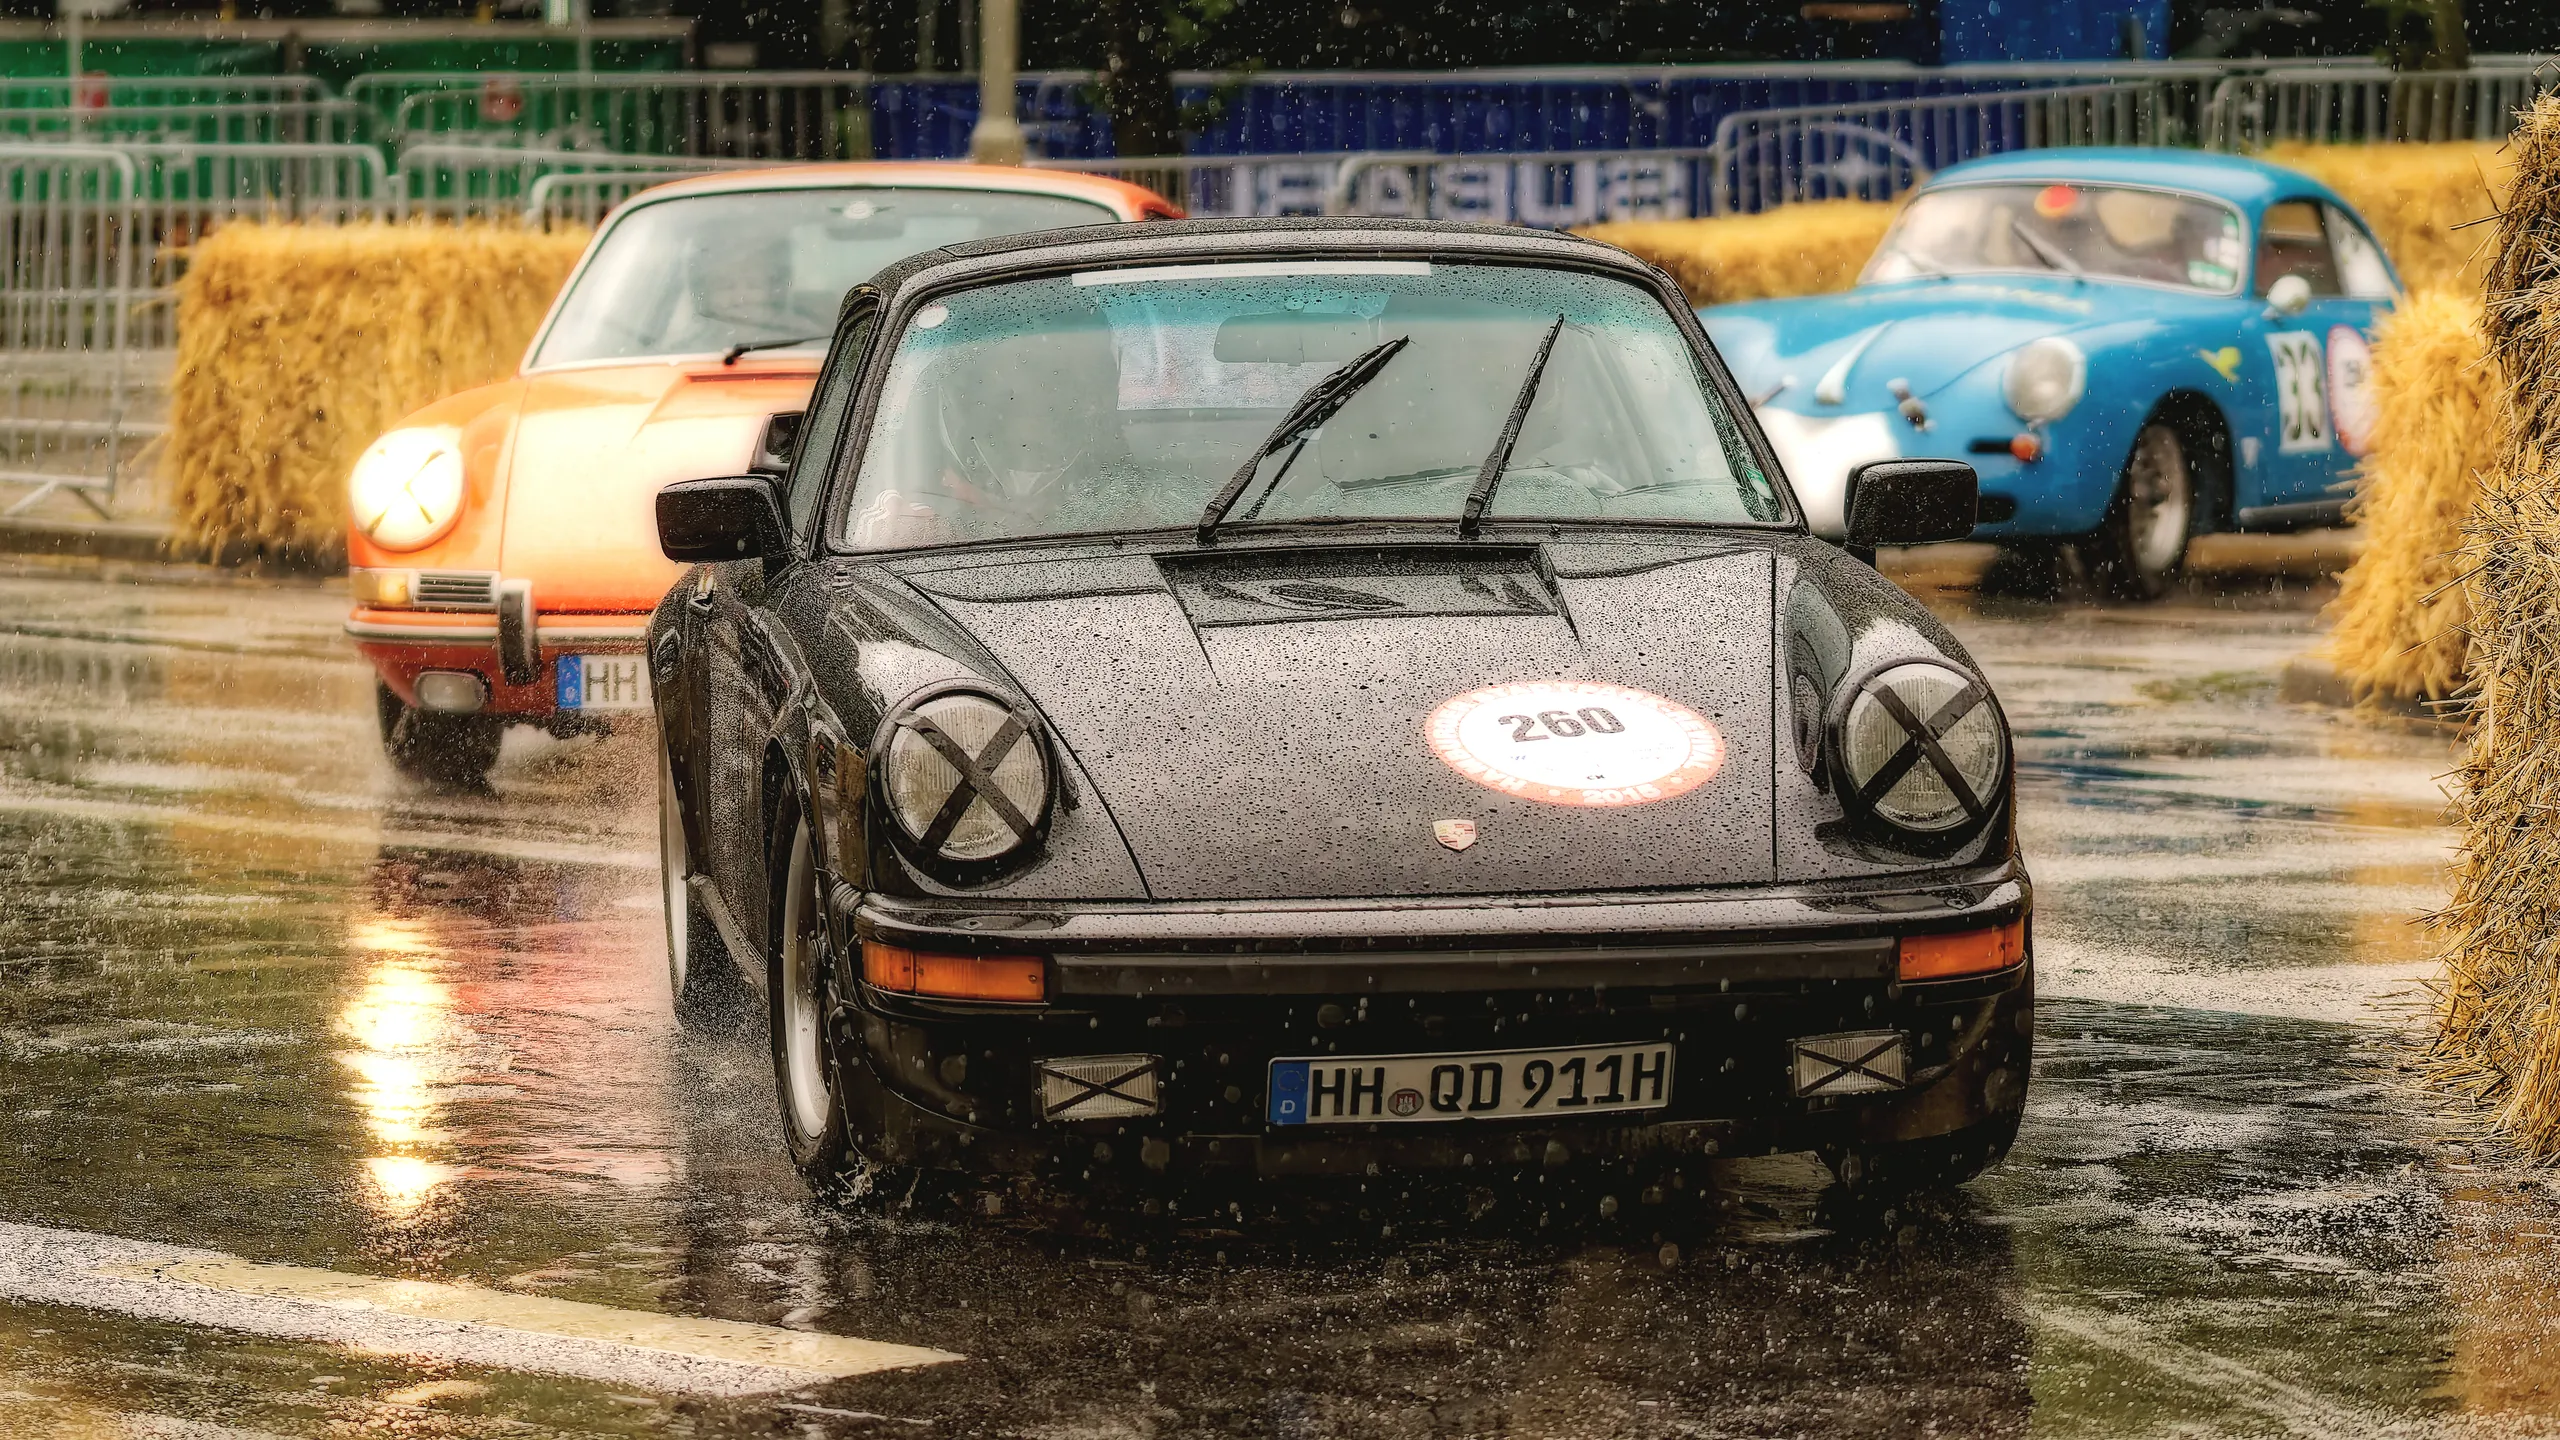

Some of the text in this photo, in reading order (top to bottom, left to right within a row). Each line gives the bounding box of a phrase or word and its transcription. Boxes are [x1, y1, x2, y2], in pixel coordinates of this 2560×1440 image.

[585, 661, 637, 702] HH
[1432, 700, 1527, 792] HAMBURGER
[1498, 707, 1626, 743] 260
[1311, 1066, 1386, 1117] HH
[1430, 1062, 1502, 1112] QD
[1523, 1051, 1667, 1109] 911H
